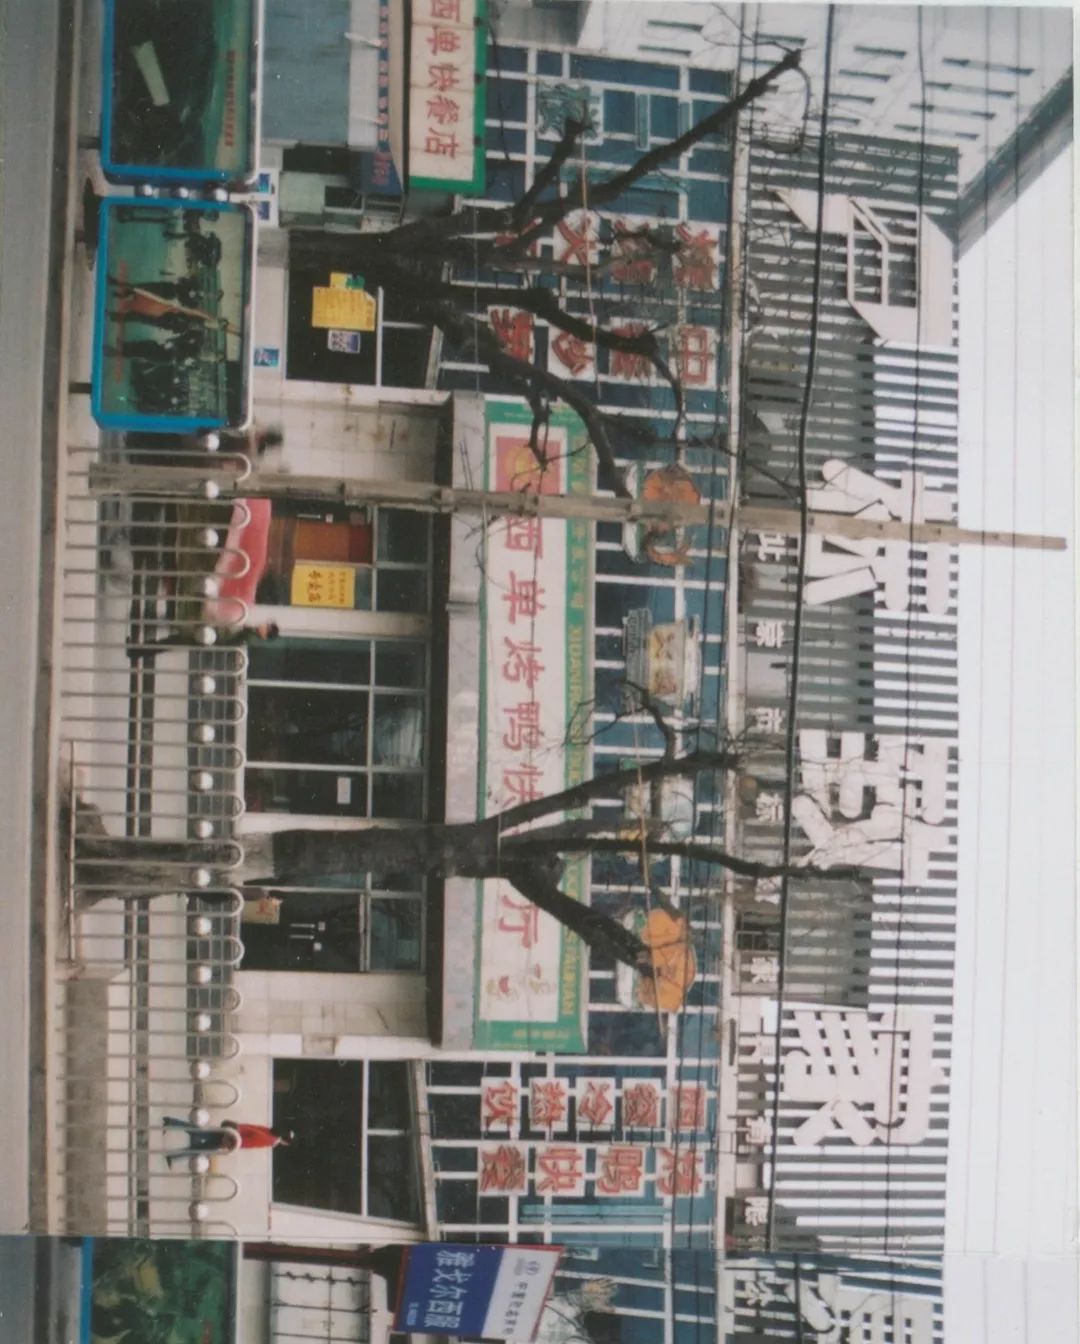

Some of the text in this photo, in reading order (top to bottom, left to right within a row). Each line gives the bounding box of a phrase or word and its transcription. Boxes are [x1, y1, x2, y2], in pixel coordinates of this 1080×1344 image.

[424, 0, 463, 160] 西单快餐店
[497, 516, 548, 949] 西单烤鸭快厅
[481, 1147, 703, 1197] 烤鸭快餐
[423, 1251, 475, 1329] 雅戈尔西服
